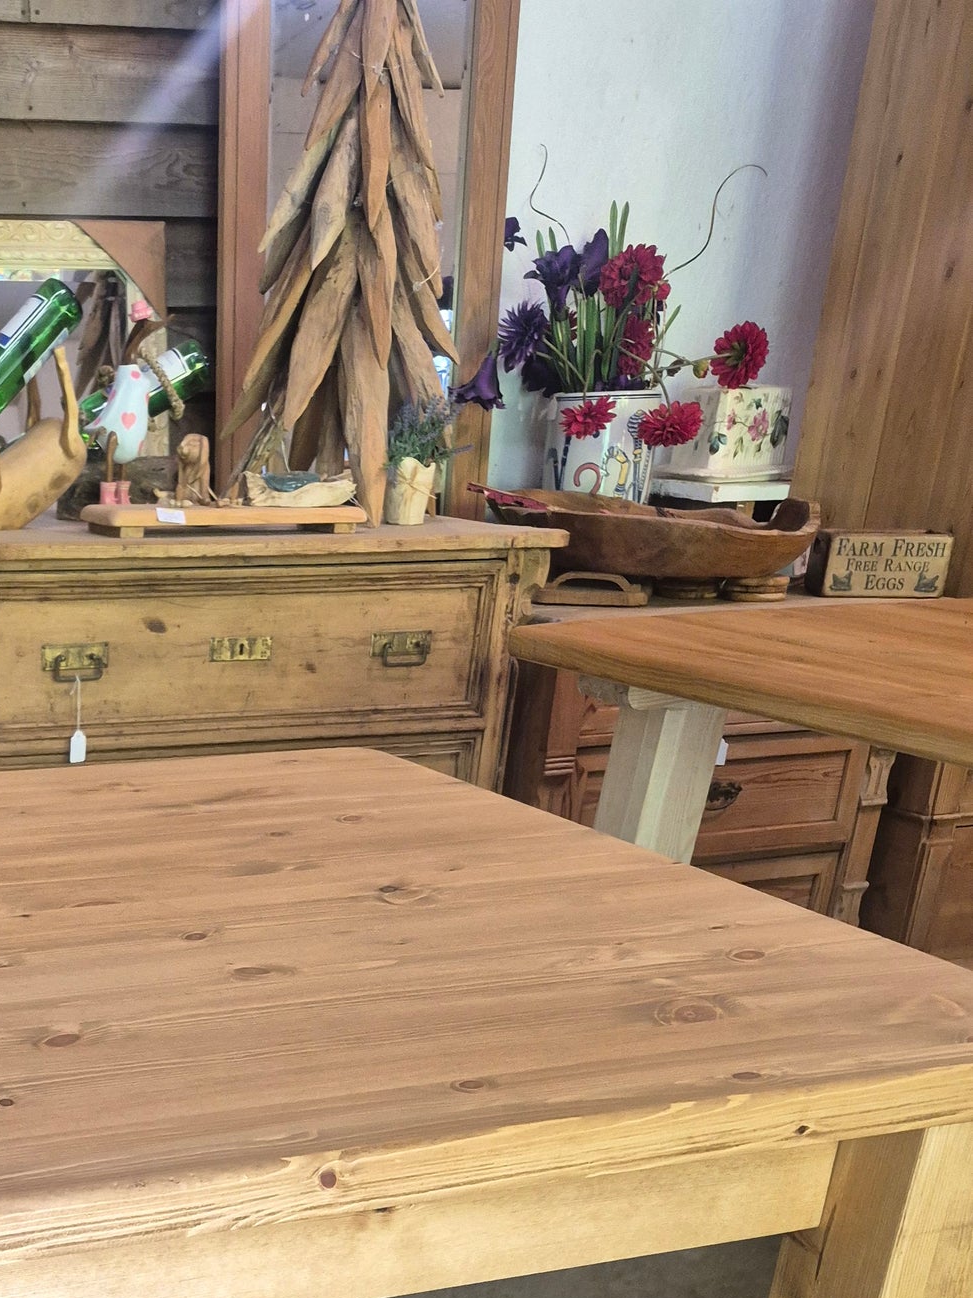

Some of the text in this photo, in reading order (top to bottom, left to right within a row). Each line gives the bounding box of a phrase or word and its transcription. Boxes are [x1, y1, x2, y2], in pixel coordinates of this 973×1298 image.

[836, 538, 948, 557] FARM FRESH
[846, 558, 930, 572] FREE RANGE
[864, 574, 905, 591] EGGS
